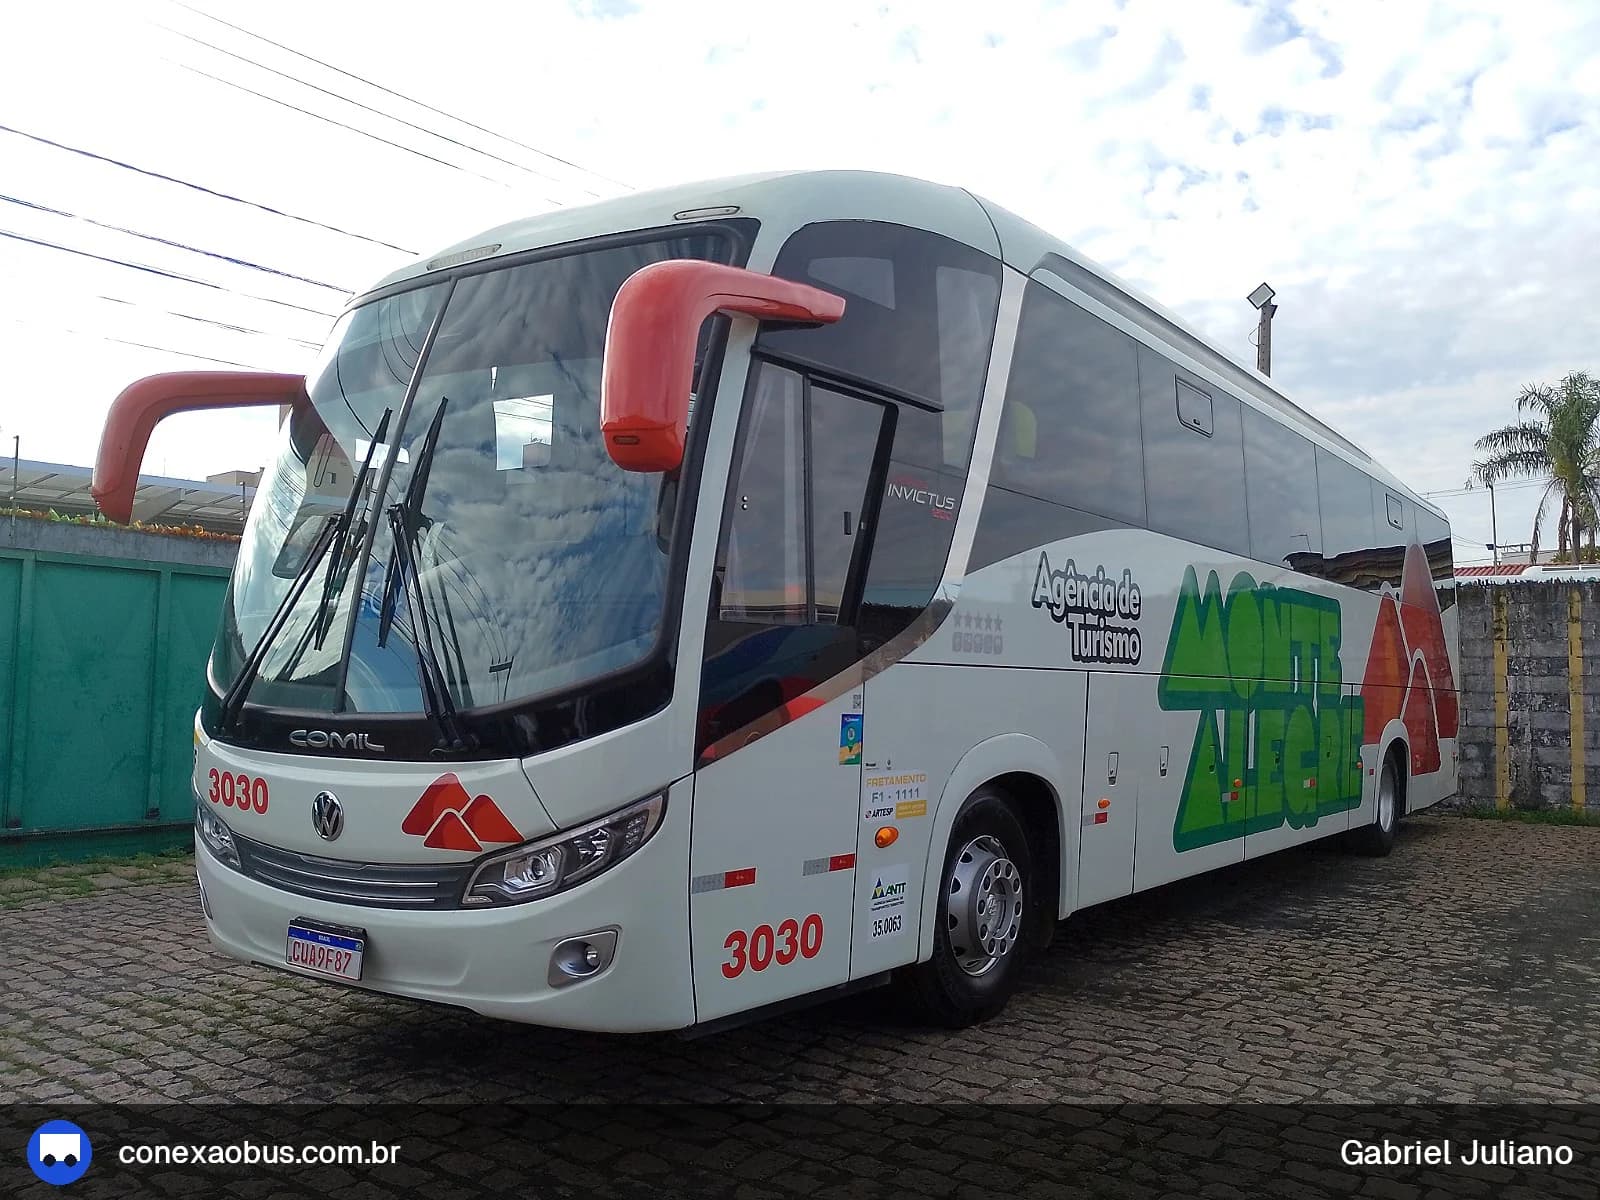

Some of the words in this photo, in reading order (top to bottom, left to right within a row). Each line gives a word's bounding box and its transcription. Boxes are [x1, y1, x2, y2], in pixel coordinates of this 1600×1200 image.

[887, 483, 956, 510] INVICTUS
[1031, 551, 1116, 623] Agência
[1118, 568, 1141, 620] de
[1066, 612, 1141, 665] Turismo
[1158, 564, 1342, 711] MONTE
[289, 729, 385, 752] COMIL
[866, 774, 927, 788] FRETAMENTO
[1173, 695, 1364, 853] ALEGRE
[208, 767, 269, 815] 3030
[895, 787, 920, 801] 1111
[871, 807, 894, 818] ARTESP
[884, 882, 906, 897] ANTT
[872, 915, 902, 937] 35.0063
[292, 940, 352, 974] CUA9F87
[721, 913, 824, 979] 3030
